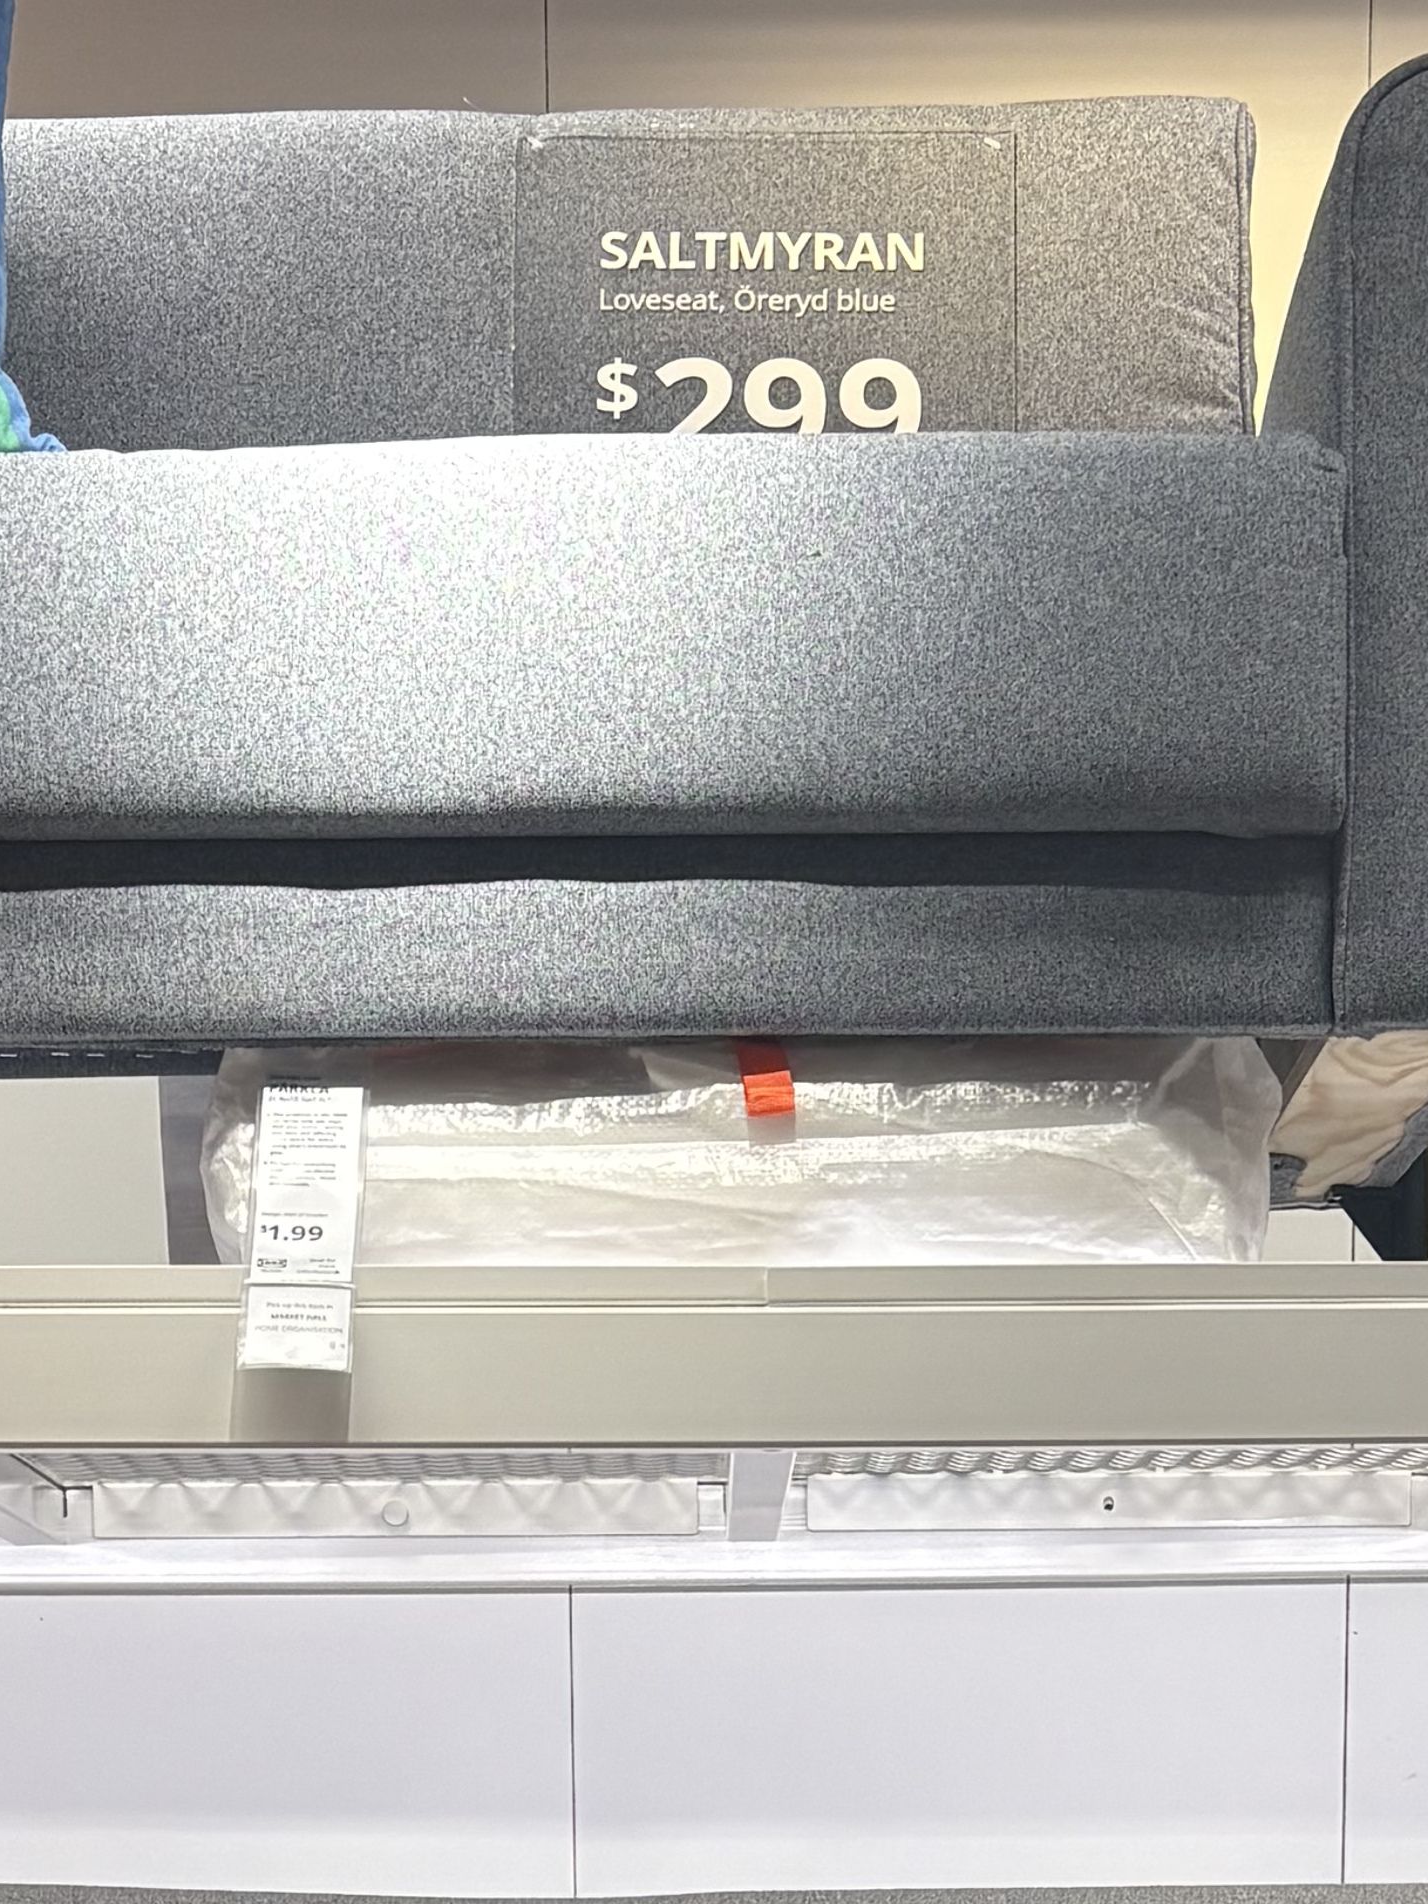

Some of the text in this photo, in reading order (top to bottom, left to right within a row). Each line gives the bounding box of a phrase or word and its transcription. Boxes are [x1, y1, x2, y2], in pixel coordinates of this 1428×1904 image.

[599, 231, 925, 272] SALTMYRAN
[599, 284, 895, 317] Loveseat, Öreryd blue
[260, 1224, 324, 1241] $1.99
